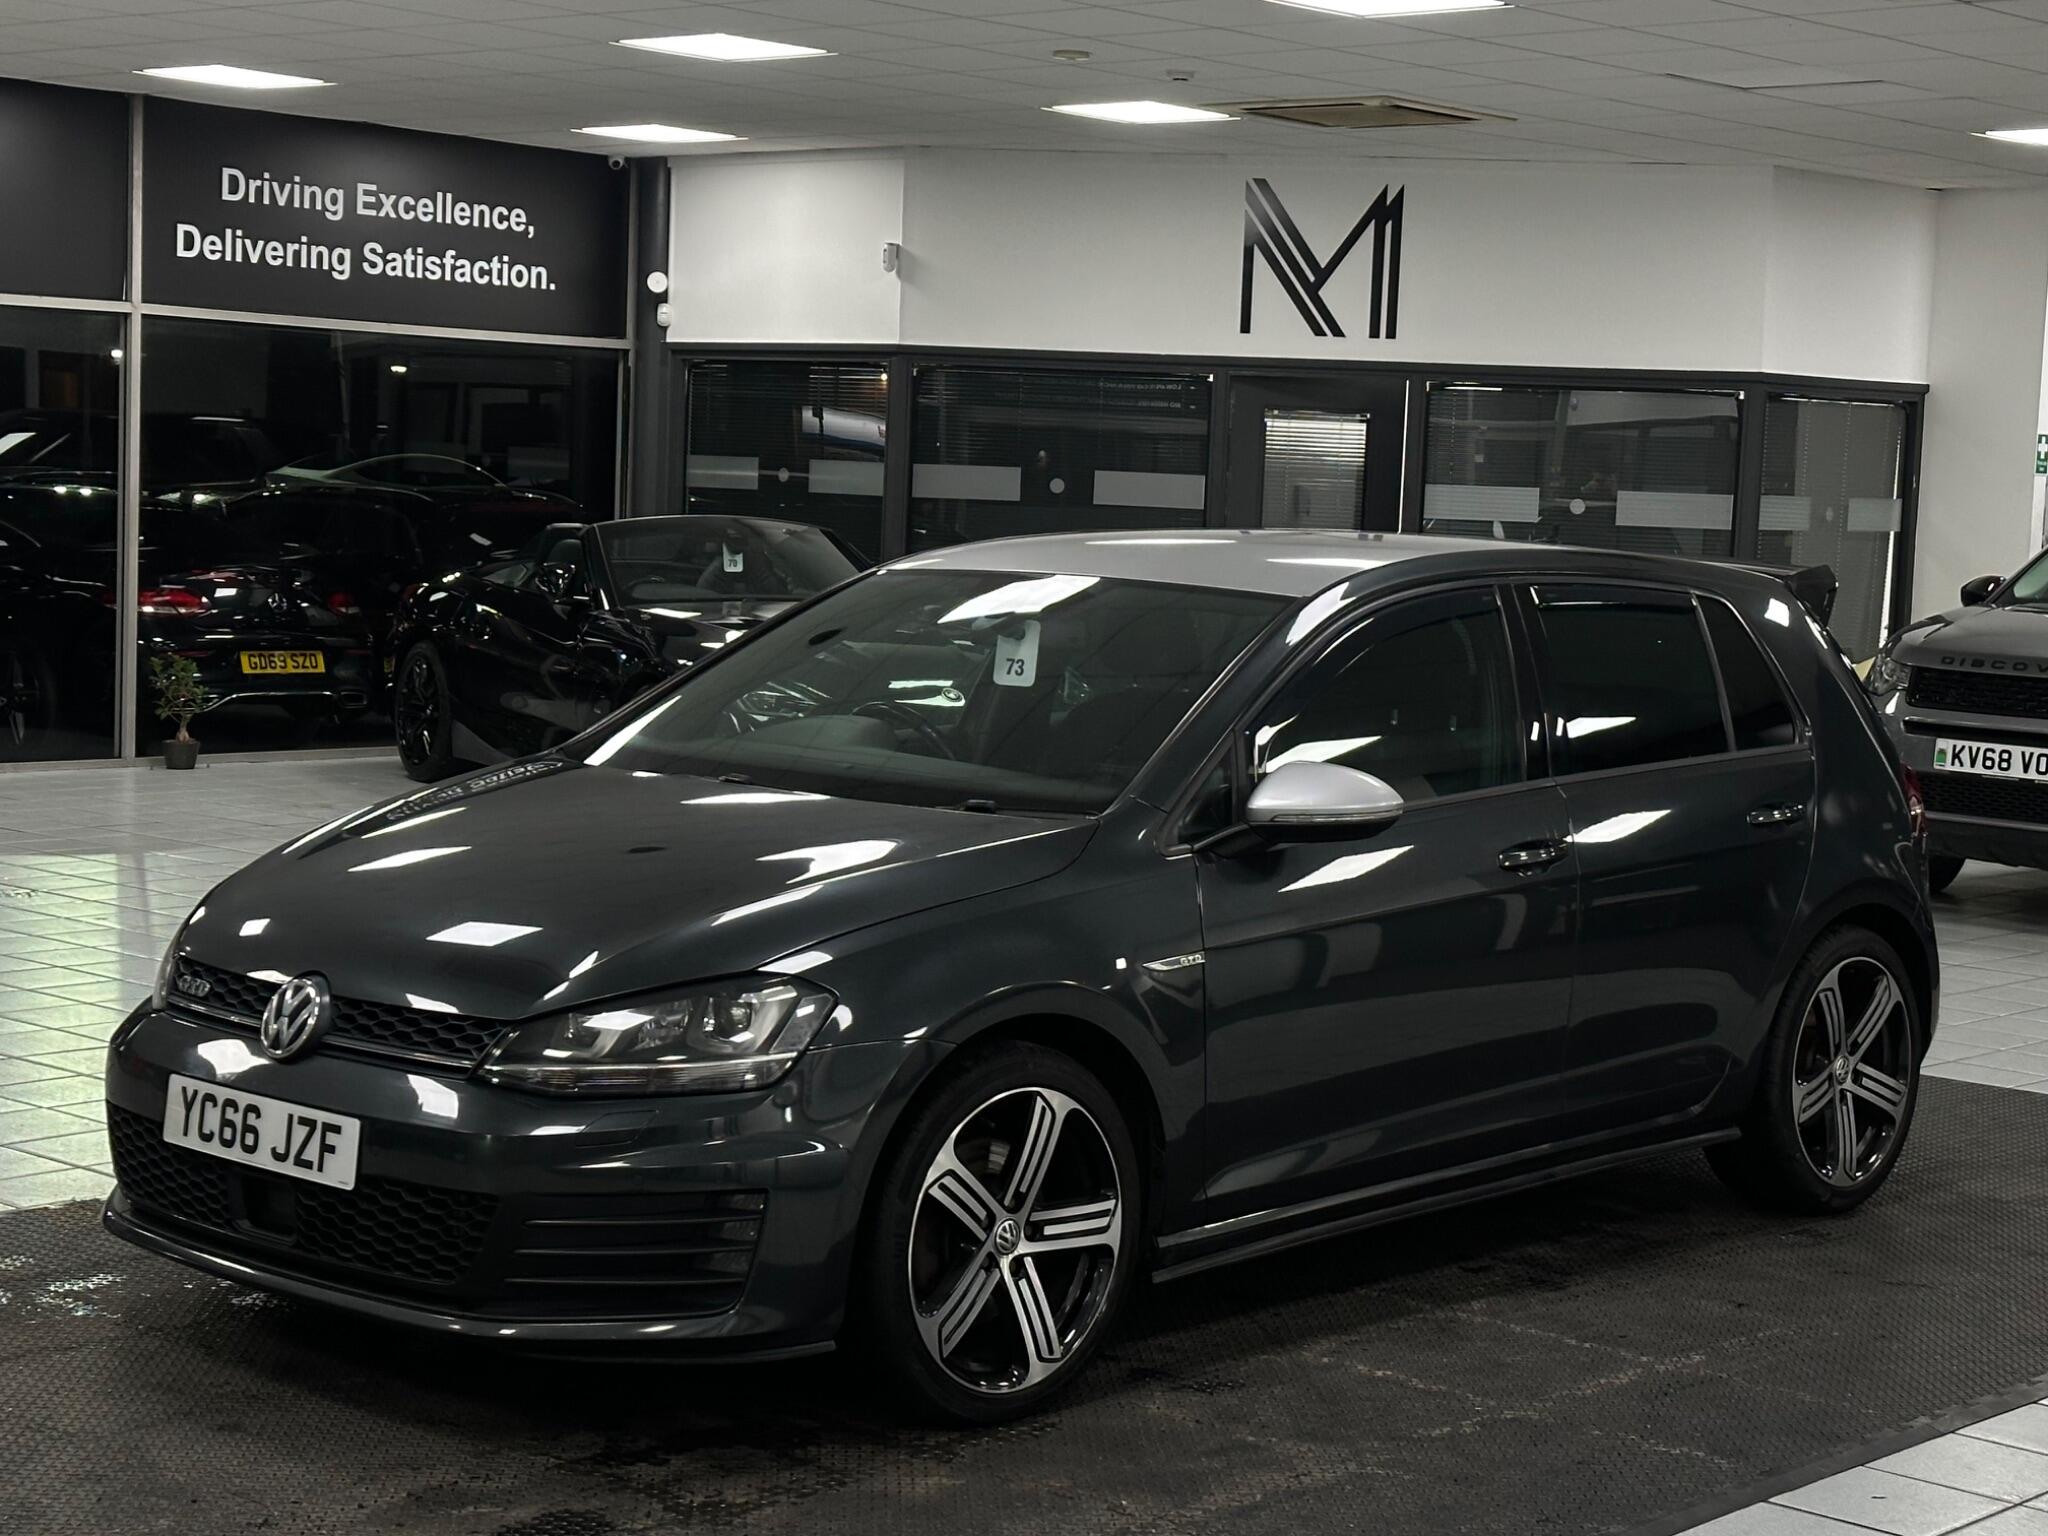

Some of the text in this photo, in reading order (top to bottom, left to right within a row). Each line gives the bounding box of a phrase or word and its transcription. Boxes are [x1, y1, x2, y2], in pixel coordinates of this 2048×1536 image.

[222, 167, 535, 239] Driving Excellence,
[175, 223, 556, 290] Delivering Satisfaction.
[248, 653, 319, 671] GD69 SZO
[1006, 658, 1025, 677] 73
[1950, 744, 2012, 772] KV68
[181, 1086, 343, 1174] YC66 JZF
